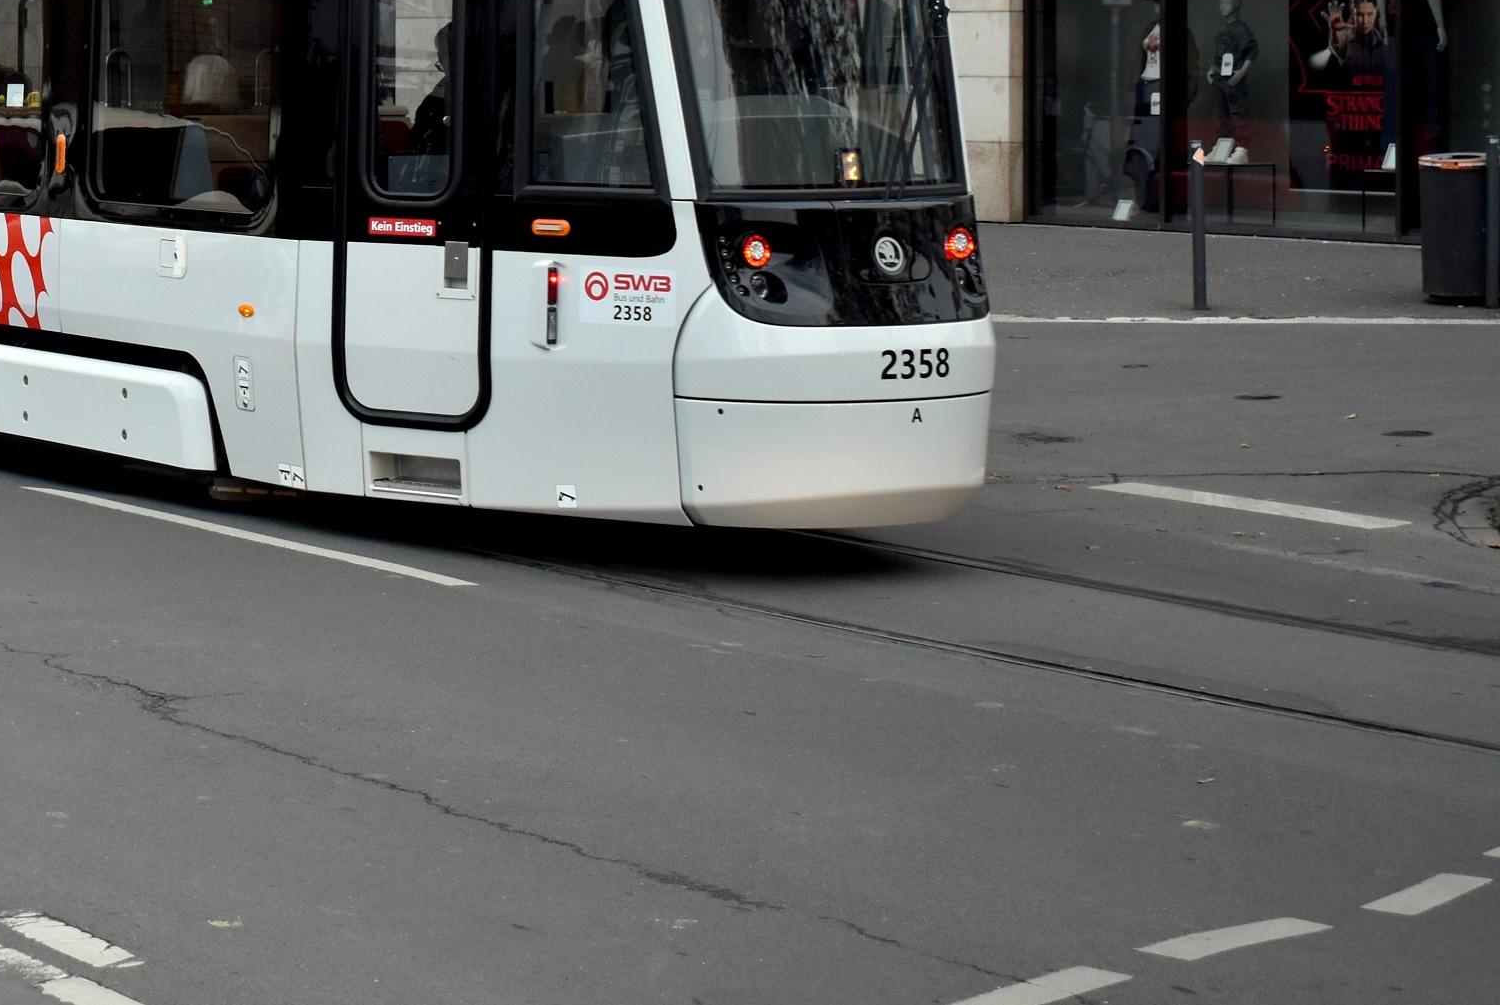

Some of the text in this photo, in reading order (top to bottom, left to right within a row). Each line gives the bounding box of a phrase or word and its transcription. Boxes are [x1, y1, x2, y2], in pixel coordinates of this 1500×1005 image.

[371, 221, 433, 236] Kein Einstieg
[614, 274, 671, 293] SWB
[613, 293, 665, 304] Bus und Bahn
[613, 305, 652, 321] 2358
[881, 347, 950, 380] 2358
[911, 407, 923, 423] A
